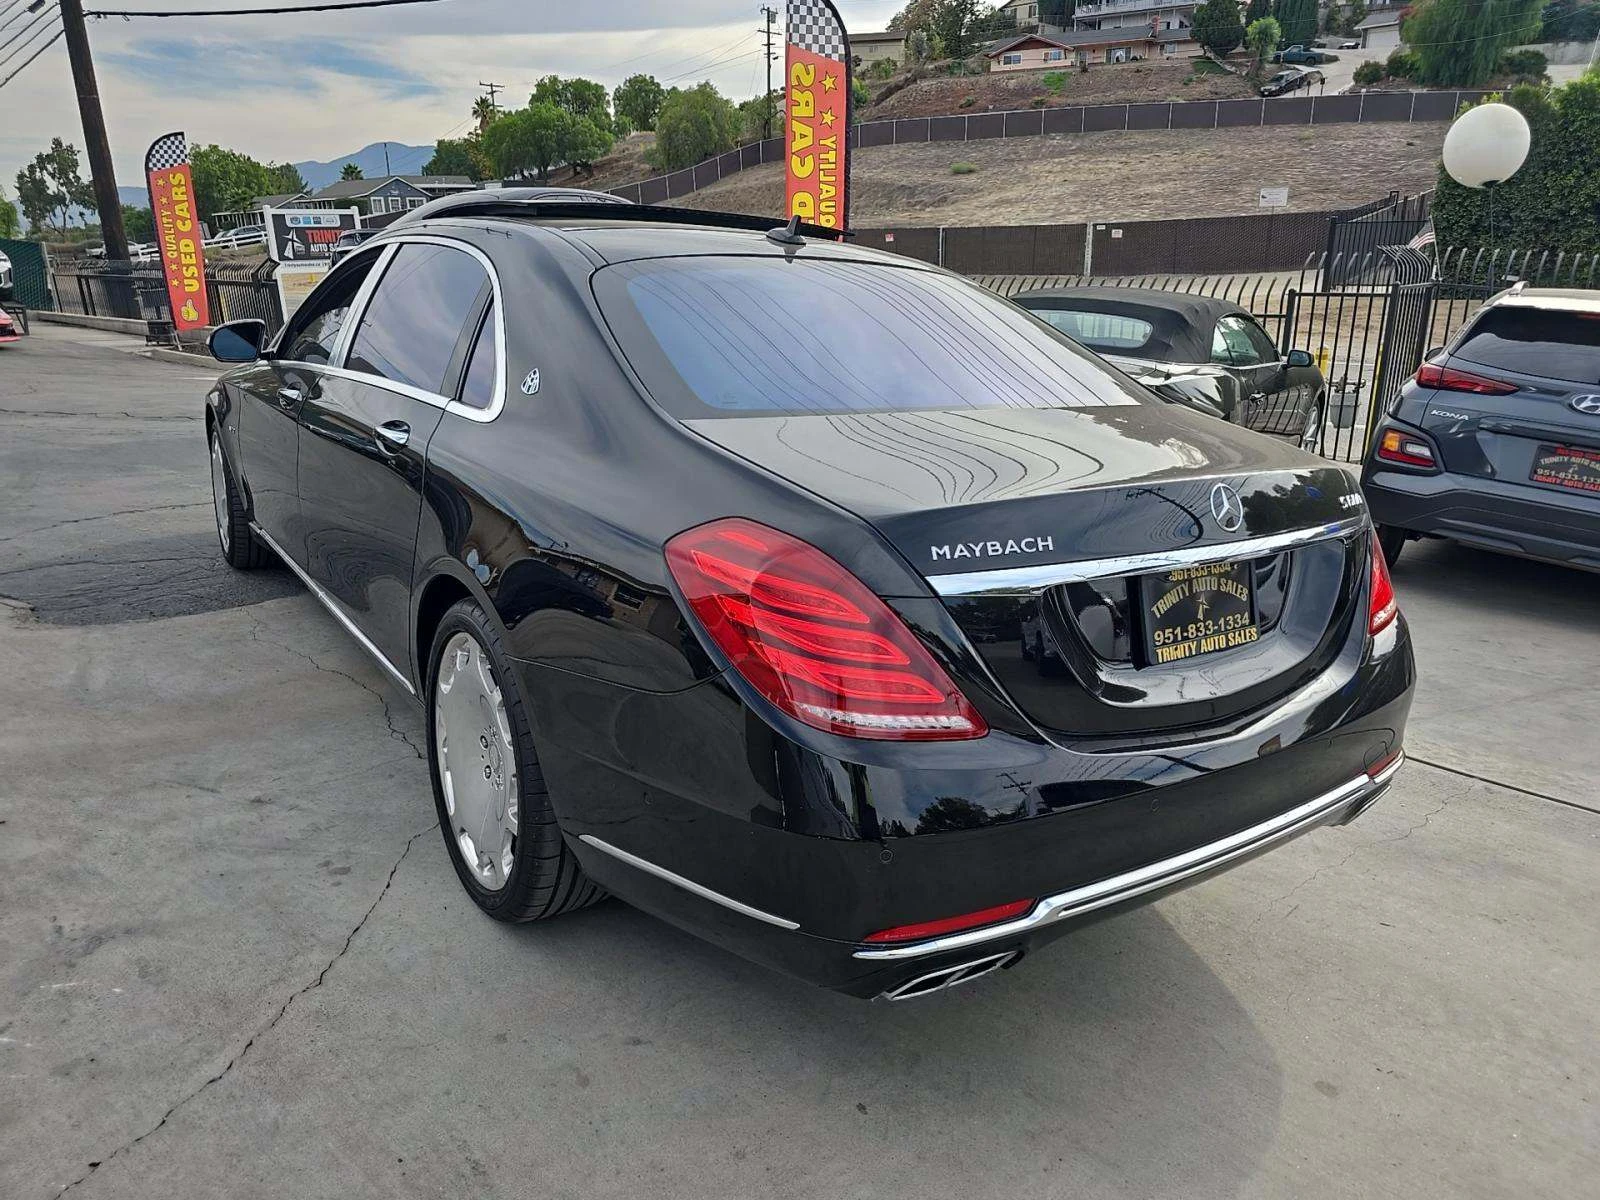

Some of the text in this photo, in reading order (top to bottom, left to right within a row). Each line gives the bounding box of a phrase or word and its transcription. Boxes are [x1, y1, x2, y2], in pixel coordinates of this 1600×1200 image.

[160, 209, 178, 259] QUALITY
[169, 172, 200, 293] USED CARS
[310, 243, 328, 253] AUTO
[1431, 409, 1468, 421] KONA
[930, 535, 1054, 561] MAYBACH
[1150, 576, 1249, 619] TRINITY AUTO SALES
[1153, 611, 1250, 646] 951-833-1334
[1155, 627, 1258, 664] TRINITY AUTO SALES
